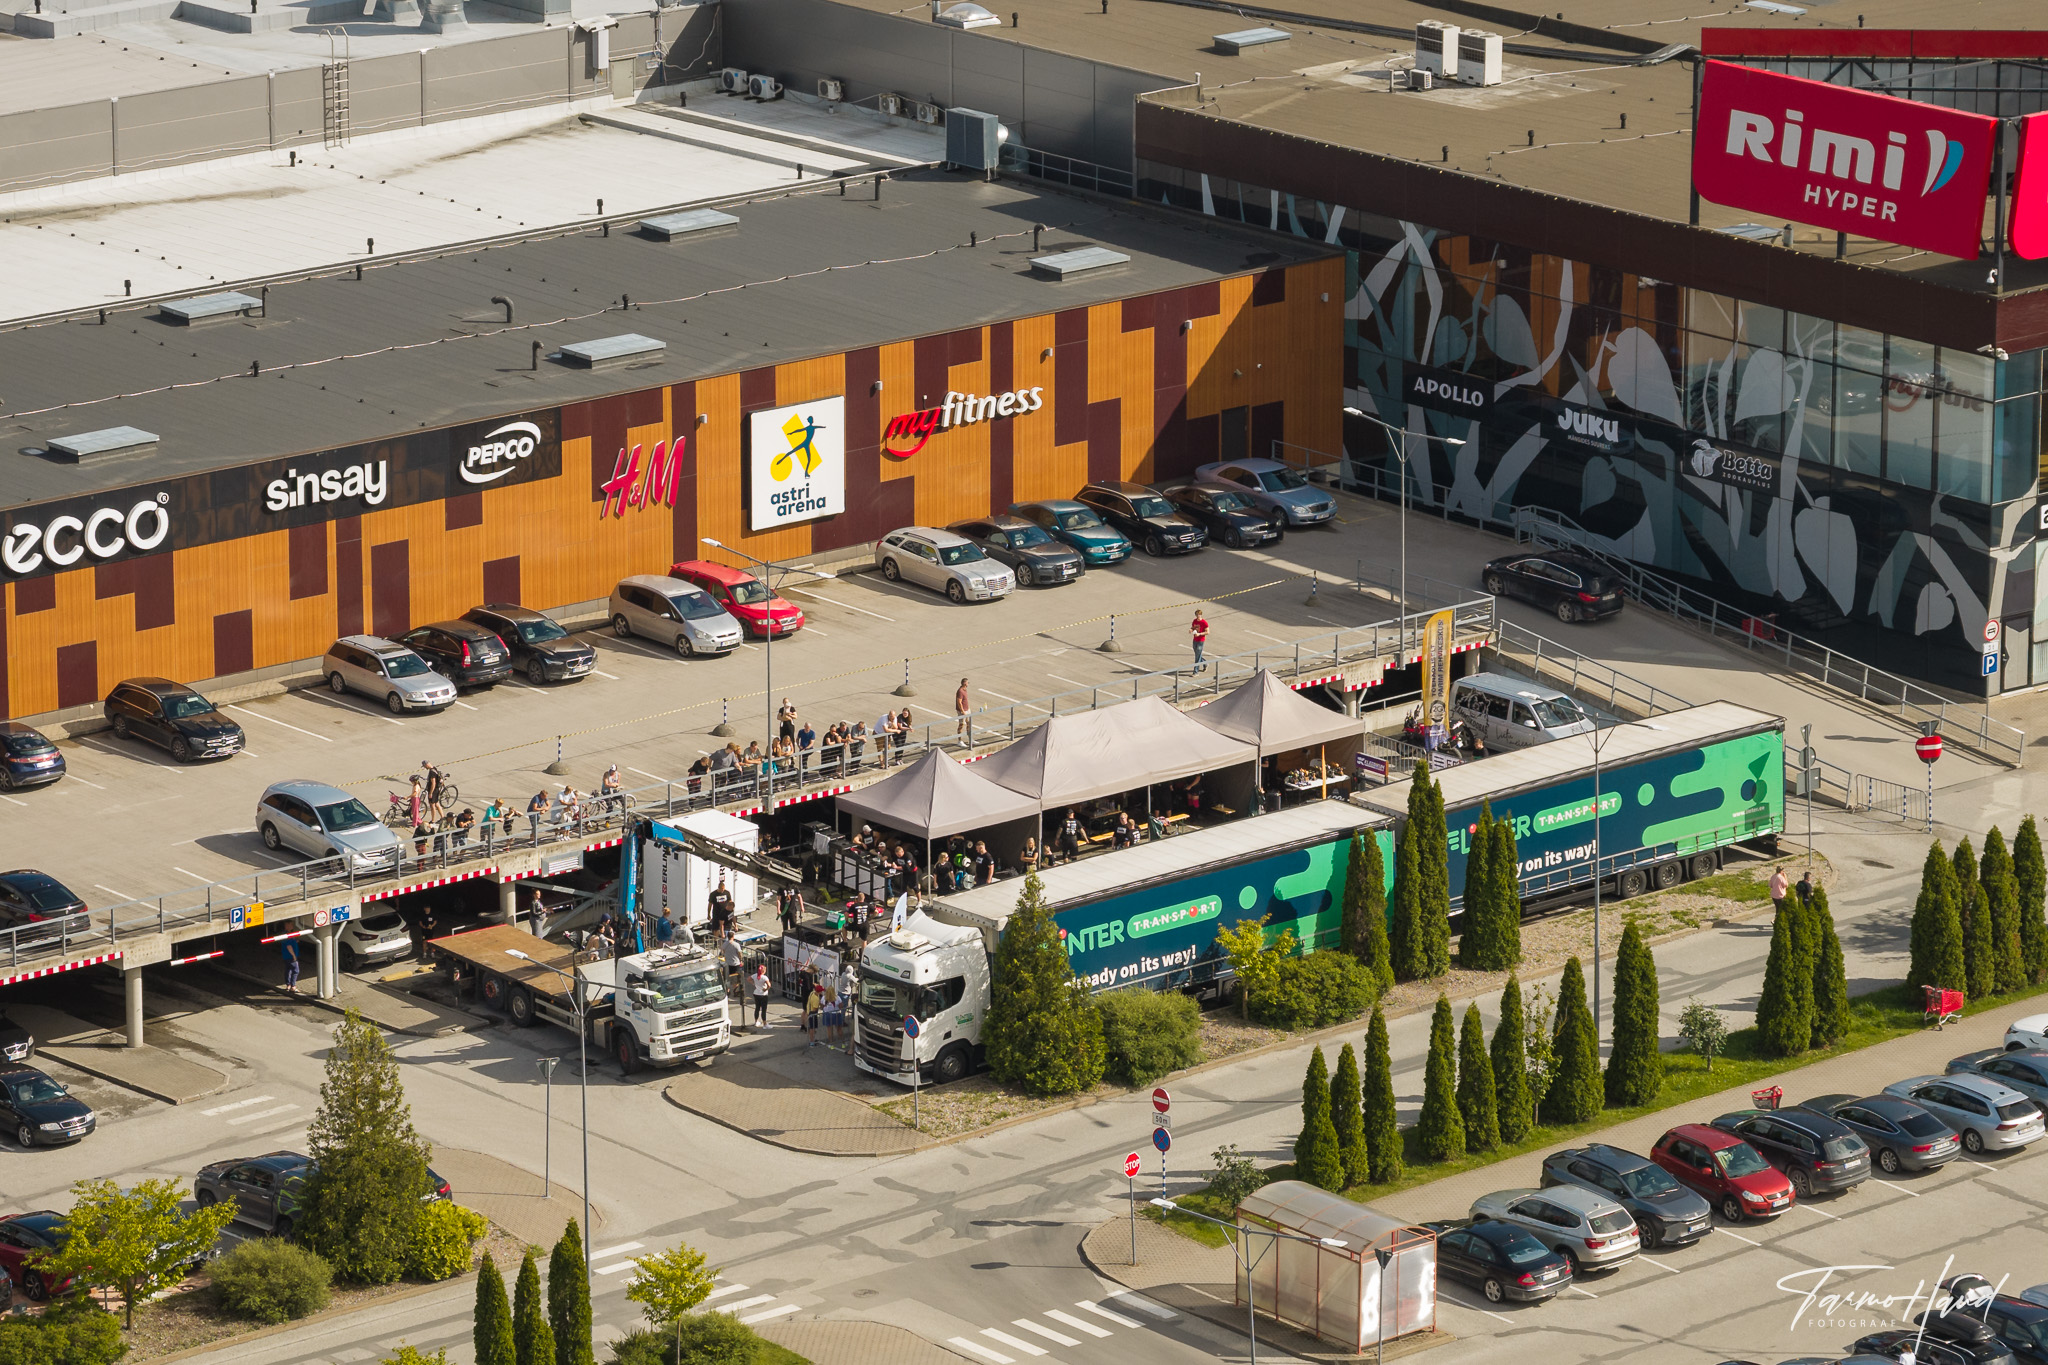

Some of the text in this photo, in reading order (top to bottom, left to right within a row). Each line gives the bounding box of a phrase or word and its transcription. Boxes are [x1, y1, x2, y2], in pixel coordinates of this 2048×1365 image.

[1725, 108, 1907, 191] Rimi
[1803, 183, 1898, 223] HYPER
[1413, 376, 1484, 407] APOLLO
[467, 436, 535, 468] PEPCO
[1721, 449, 1773, 480] Betta
[266, 459, 387, 511] sinsay
[600, 435, 687, 518] H&M
[1722, 471, 1771, 489] ZOOKAUPLUS
[770, 483, 811, 506] astri
[776, 494, 827, 517] arena
[1986, 655, 1996, 674] P
[1525, 857, 1543, 873] on
[1545, 850, 1562, 867] its
[1565, 839, 1596, 861] way!
[233, 909, 241, 923] P
[1120, 963, 1139, 979] on
[1141, 956, 1160, 973] its
[1162, 944, 1197, 968] way!
[868, 1018, 891, 1031] SCANIA
[1125, 1160, 1141, 1171] STOP
